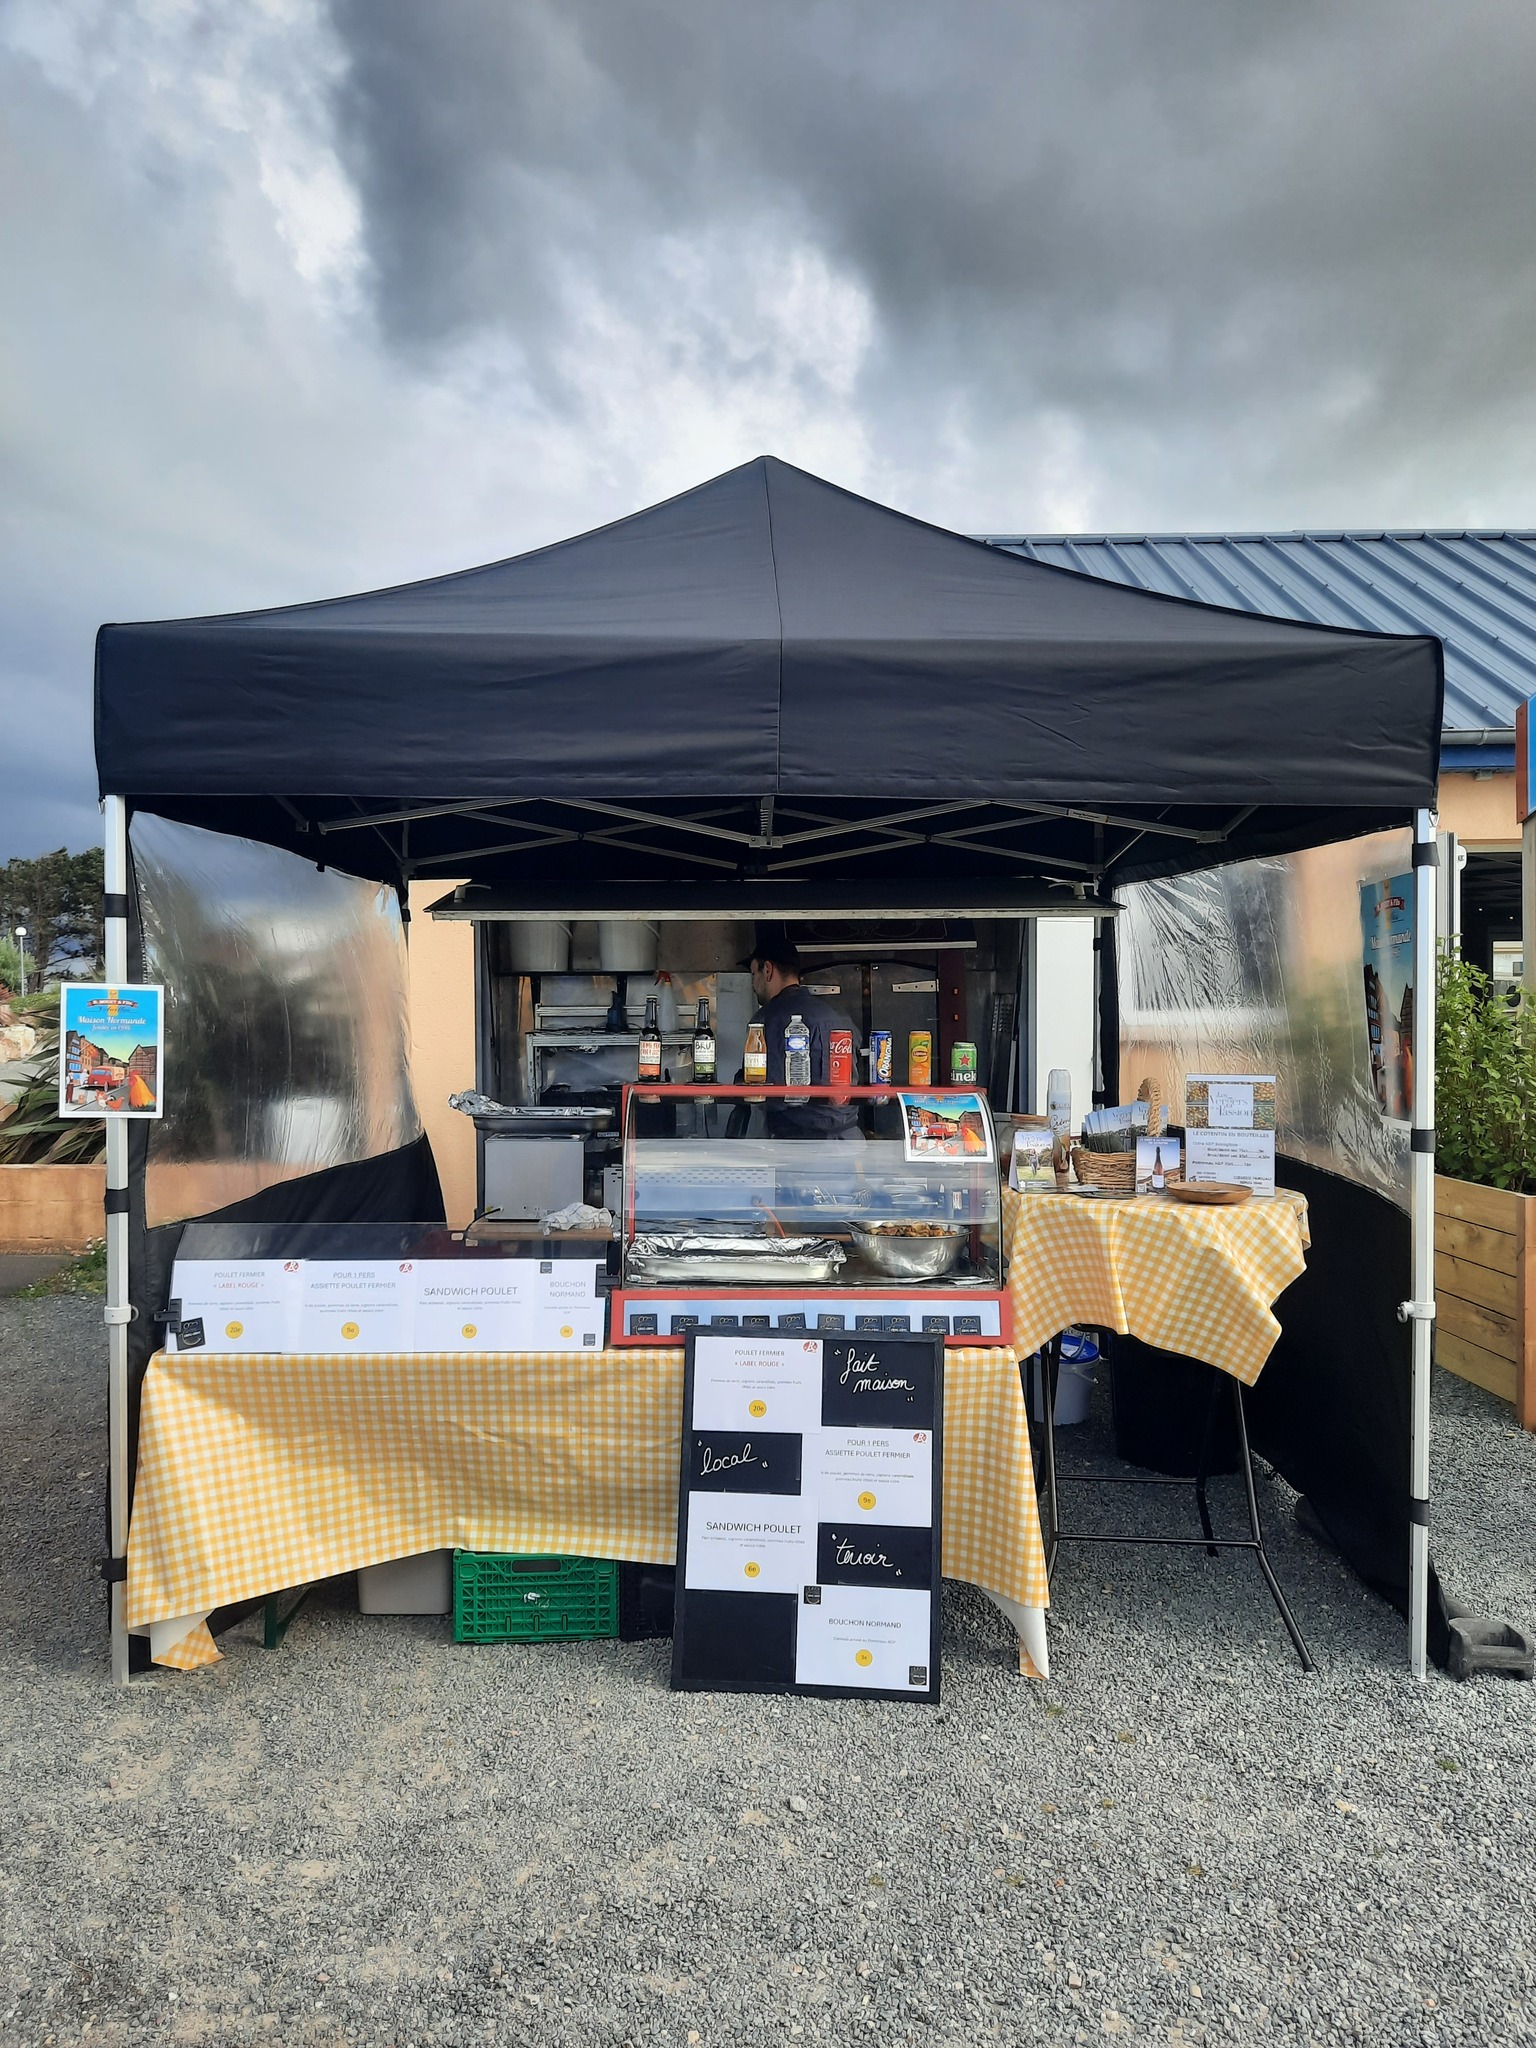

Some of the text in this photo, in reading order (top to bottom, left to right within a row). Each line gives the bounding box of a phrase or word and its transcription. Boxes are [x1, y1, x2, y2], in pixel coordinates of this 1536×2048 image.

[78, 1016, 147, 1025] Maison Normande
[695, 1041, 714, 1050] BRUT
[424, 1286, 518, 1296] SANDWICH POULET
[759, 1349, 785, 1357] FERMIER
[825, 1449, 911, 1459] ASSIETTE POULET FERMIER
[706, 1521, 802, 1534] SANDWICH POULET
[828, 1618, 902, 1629] BOUCHON NORMAND
